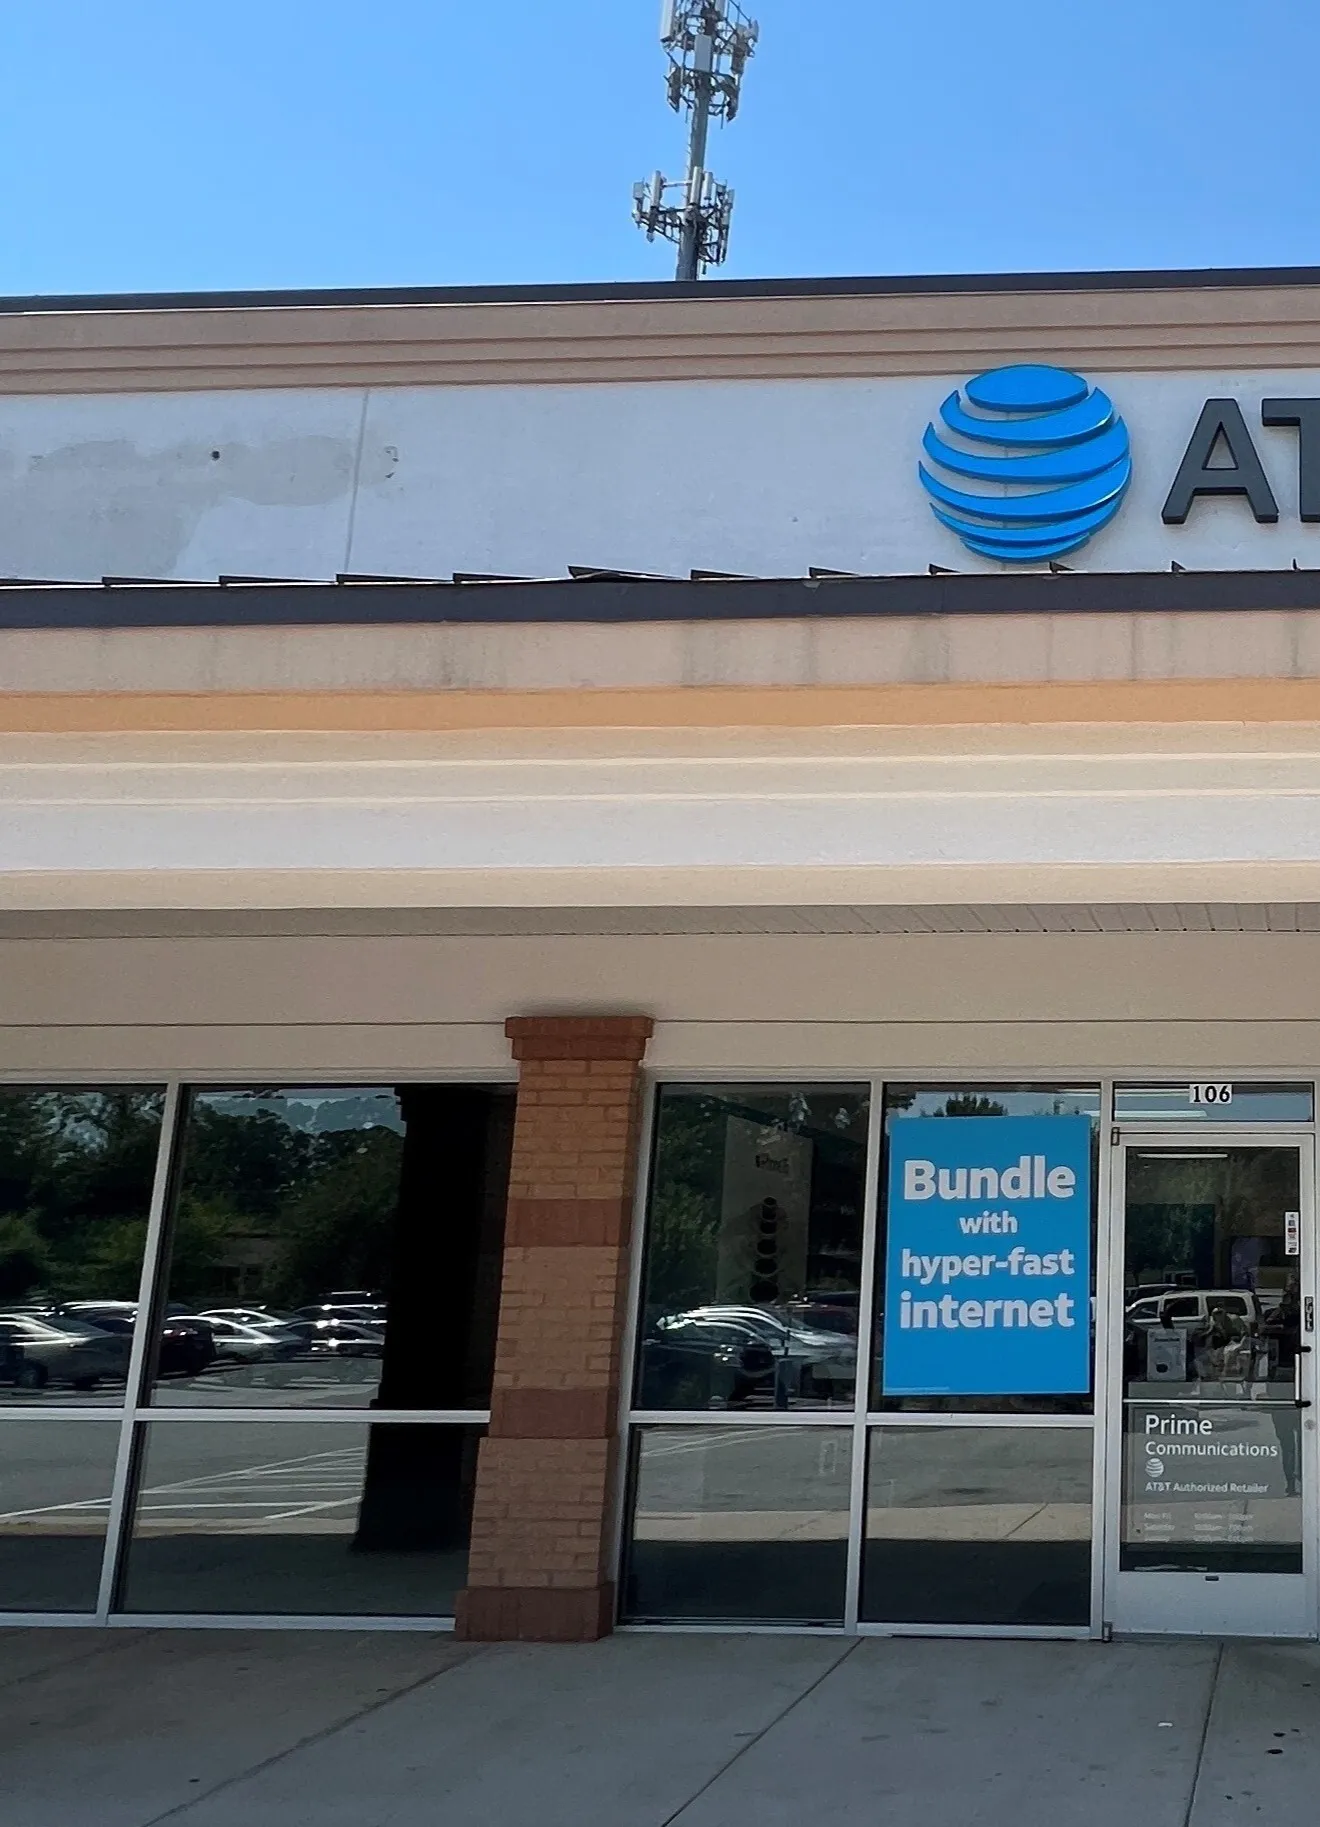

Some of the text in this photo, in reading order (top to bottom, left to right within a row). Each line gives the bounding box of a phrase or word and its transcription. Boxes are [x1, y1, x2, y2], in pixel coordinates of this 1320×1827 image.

[1193, 1085, 1231, 1103] 106
[903, 1155, 1076, 1201] Bundle
[959, 1210, 1018, 1235] with
[901, 1246, 1075, 1285] hyper-fast
[900, 1290, 1075, 1329] internet
[1145, 1413, 1213, 1436] Prime
[1145, 1441, 1279, 1458] Communications
[1145, 1481, 1269, 1493] AT&T Authorized Retailer
